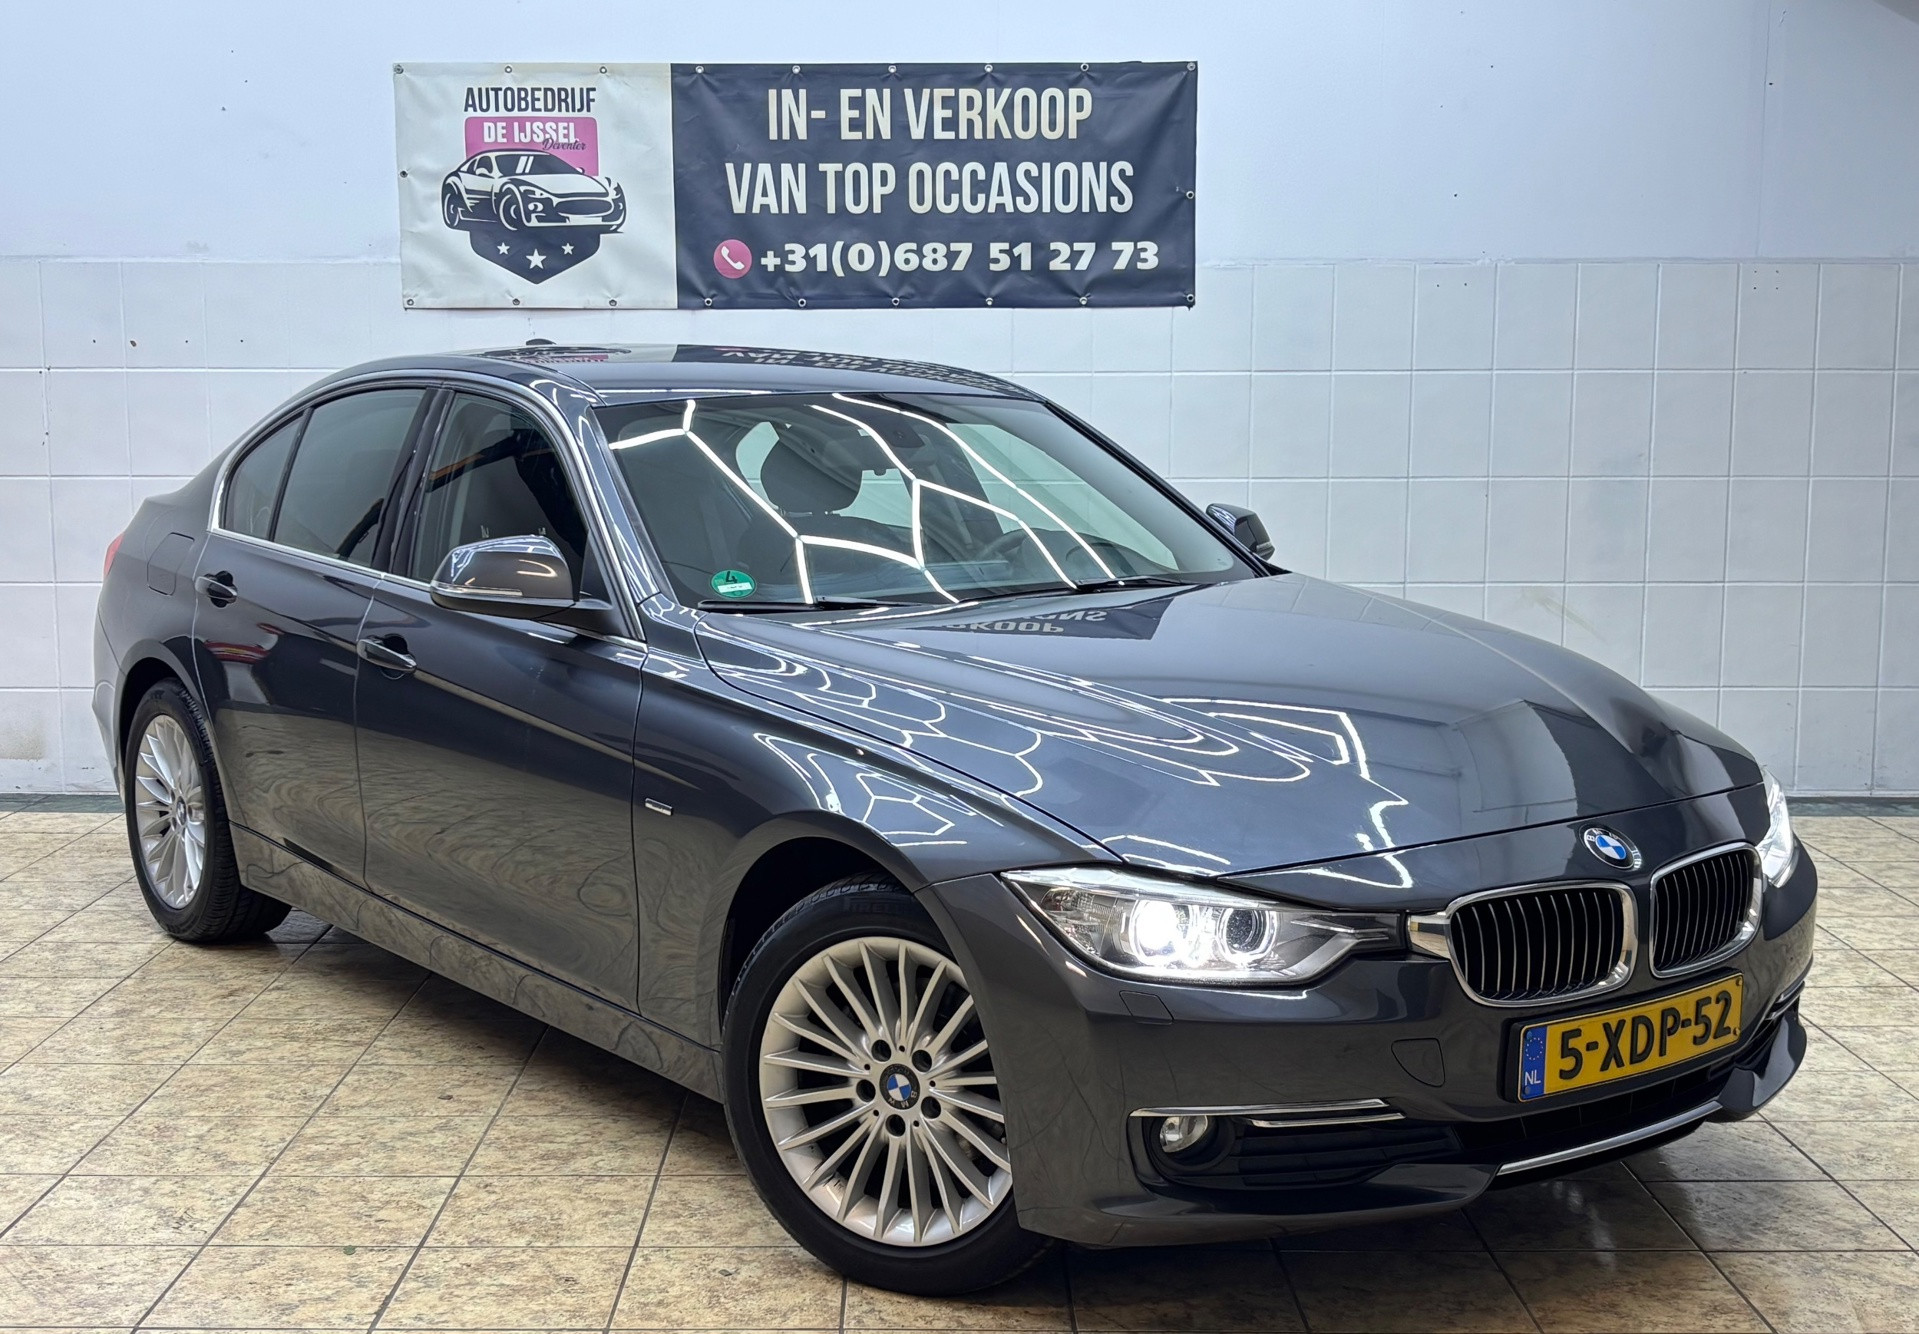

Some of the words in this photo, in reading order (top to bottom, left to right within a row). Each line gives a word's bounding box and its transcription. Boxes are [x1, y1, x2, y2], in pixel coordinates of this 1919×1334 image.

[464, 86, 597, 113] AUTOBEDRIJF
[768, 88, 826, 141] IN-
[840, 88, 892, 140] EN
[903, 87, 1093, 140] VERKOOP
[483, 121, 508, 143] DE
[513, 121, 580, 144] IJSSEL
[541, 137, 587, 151] Deventer
[725, 162, 806, 215] VAN
[818, 162, 897, 214] TOP
[908, 160, 1134, 214] OCCASIONS
[760, 239, 973, 277] +31(0)687
[988, 242, 1033, 271] 51
[1049, 242, 1096, 271] 27
[1111, 241, 1159, 270] 73
[726, 571, 738, 584] 4
[1559, 990, 1733, 1080] 5-XDP-52
[1525, 1069, 1541, 1086] NL
